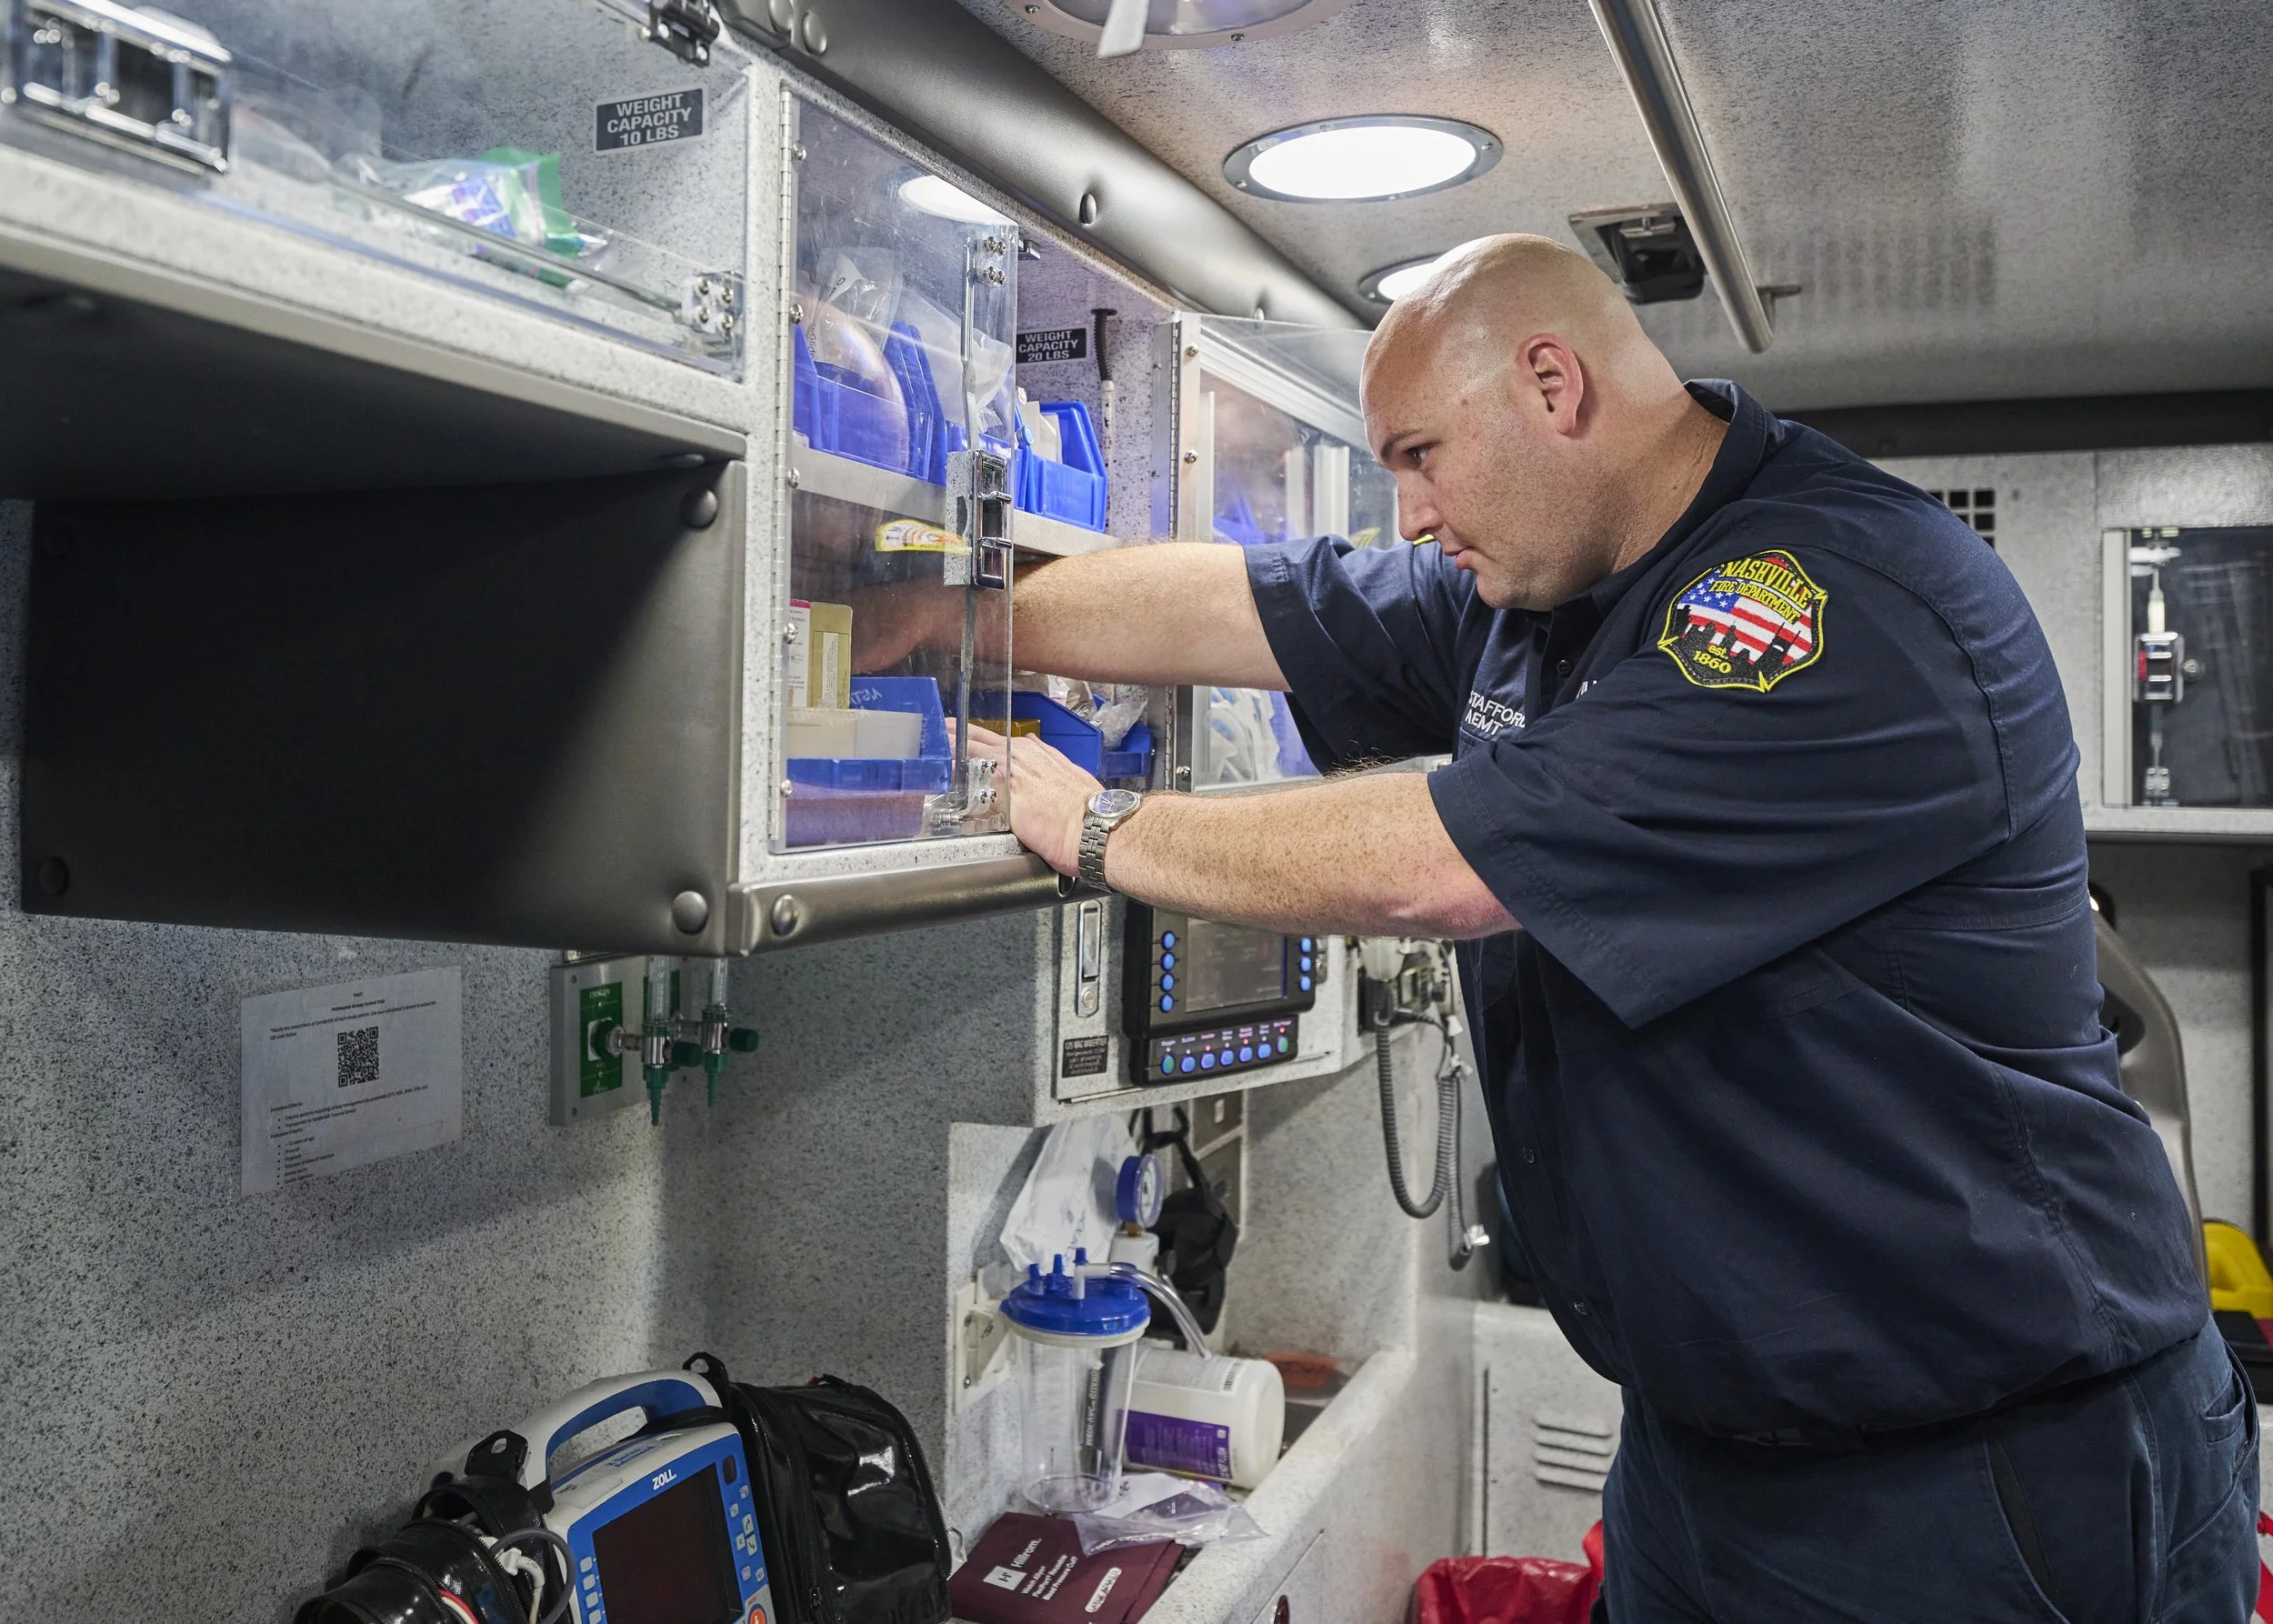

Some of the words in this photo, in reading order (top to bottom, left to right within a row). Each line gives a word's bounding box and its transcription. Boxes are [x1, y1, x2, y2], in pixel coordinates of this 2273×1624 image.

[616, 94, 683, 117] WEIGHT
[606, 107, 692, 134] CAPACITY
[620, 131, 641, 145] 10
[646, 125, 679, 142] LBS
[1018, 339, 1078, 354] CAPACITY
[1026, 330, 1072, 343] WEIGHT
[1027, 352, 1043, 362] 20
[1046, 350, 1069, 360] LBS
[1718, 558, 1813, 609] NASHVILLE
[1708, 580, 1736, 593] FIRE
[1737, 582, 1801, 624] DEPARTMENT
[1694, 650, 1732, 674] 1860
[1707, 644, 1729, 660] est.
[1465, 708, 1504, 735] AEMT
